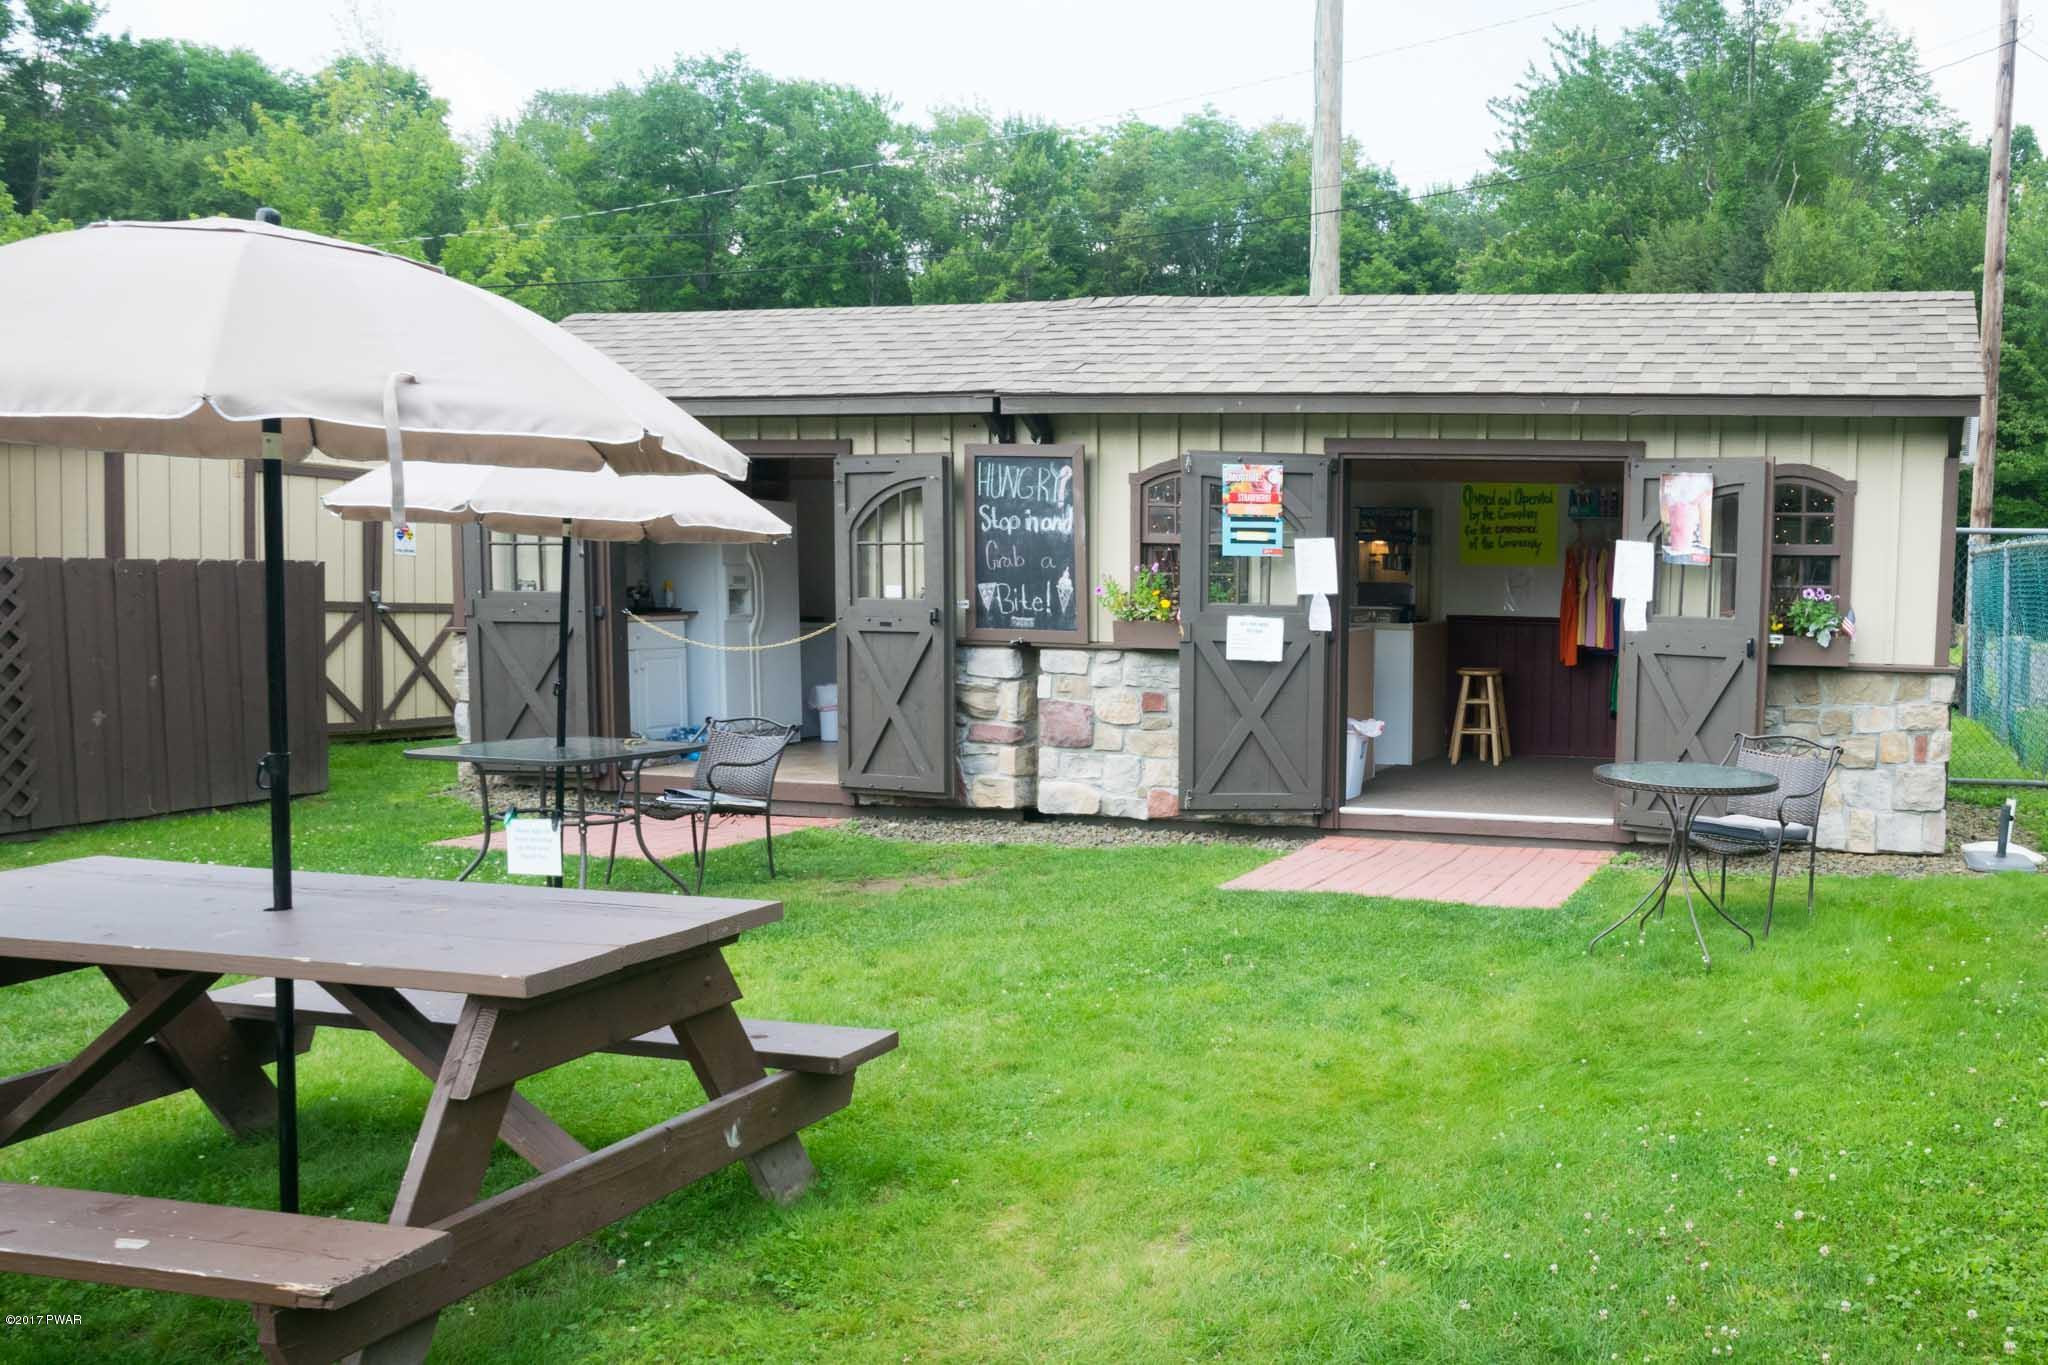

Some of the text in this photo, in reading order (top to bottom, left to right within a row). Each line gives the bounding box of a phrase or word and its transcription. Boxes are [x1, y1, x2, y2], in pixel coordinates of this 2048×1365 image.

[978, 461, 1072, 508] HUNGRY?
[979, 504, 1073, 535] Stop in and
[985, 540, 1056, 570] Grab a
[996, 581, 1052, 614] Bite!
